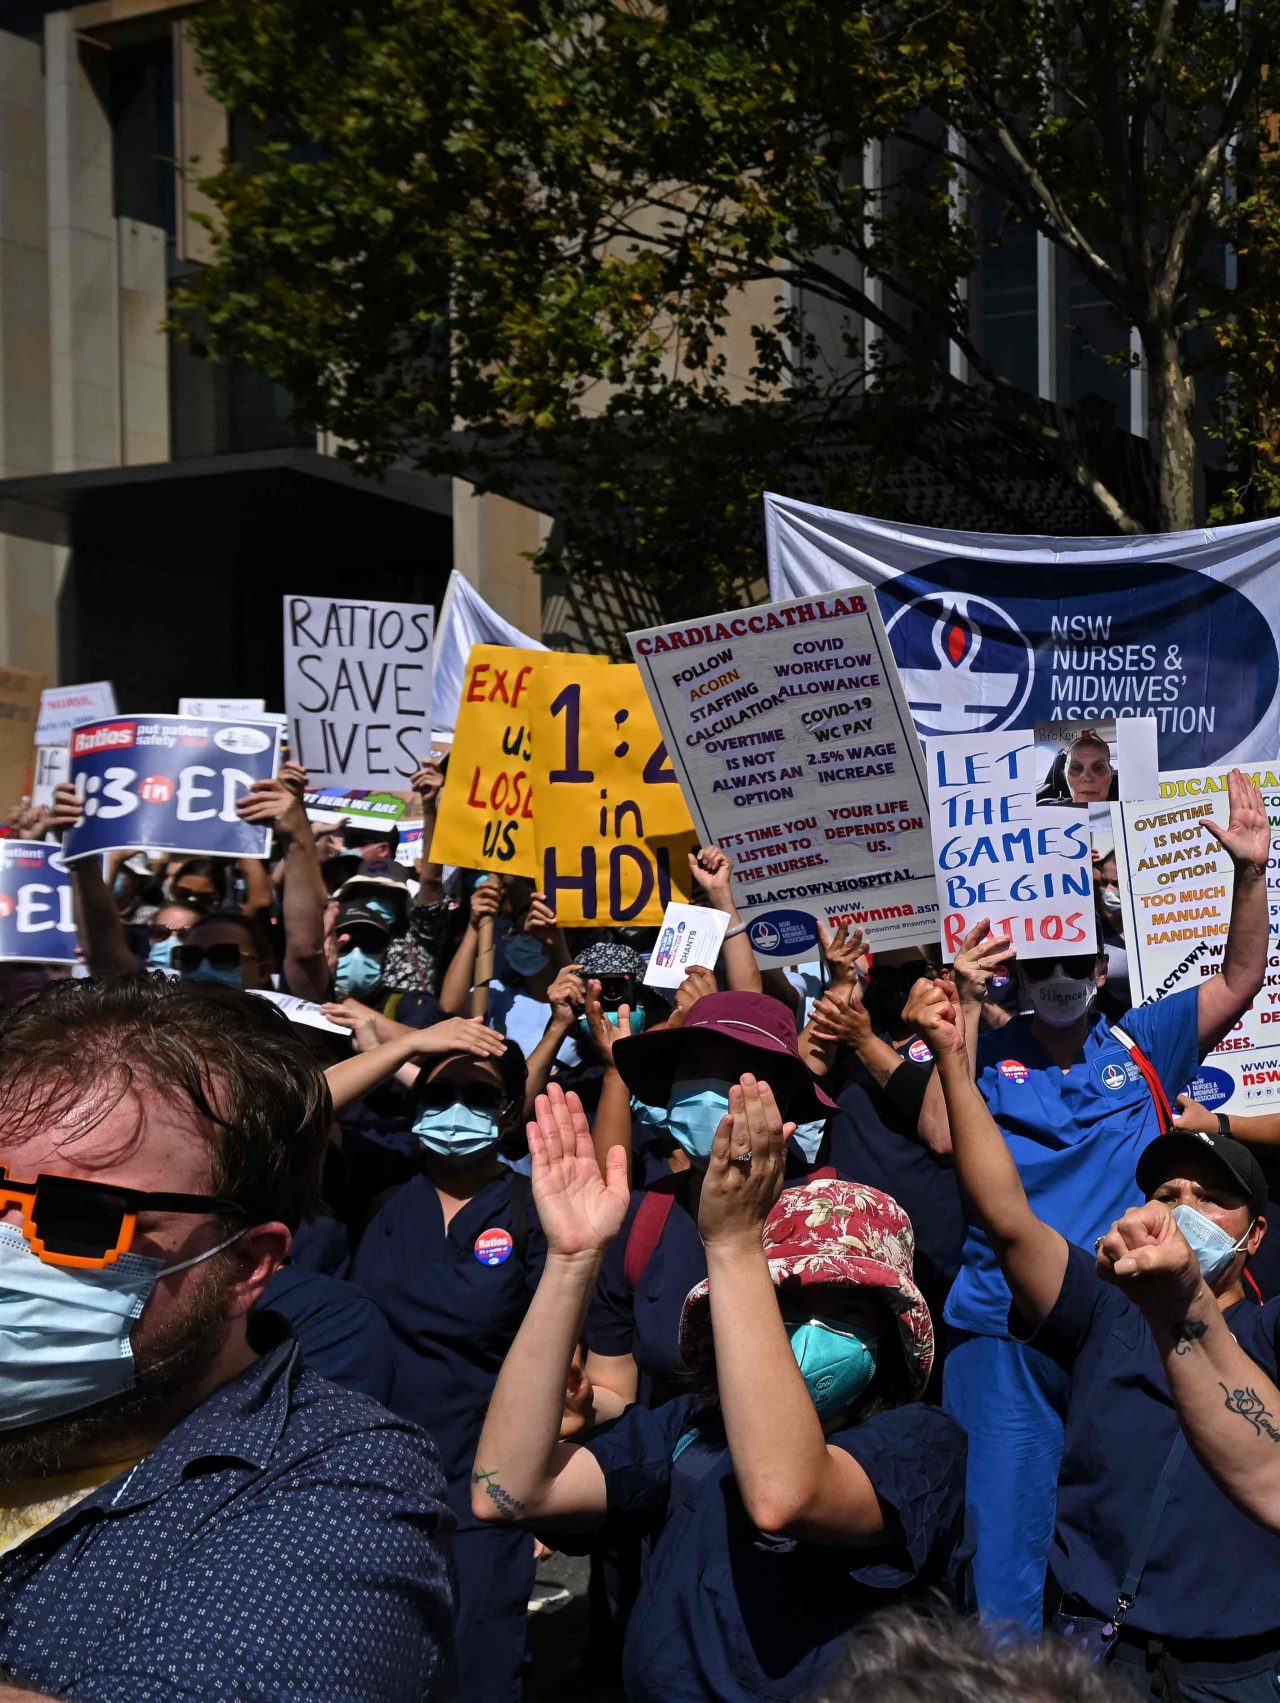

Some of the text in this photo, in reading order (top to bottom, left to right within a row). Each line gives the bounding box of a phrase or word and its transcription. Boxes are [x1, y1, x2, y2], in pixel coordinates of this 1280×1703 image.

[289, 598, 430, 653] RATIOS
[636, 595, 868, 656] CARDIAC CATH LAB
[1050, 615, 1112, 641] NSW
[792, 637, 844, 655] COVID
[1052, 644, 1183, 671] NURSES &
[672, 648, 734, 688] FOLLOW
[774, 654, 872, 677] WORKFLOW
[297, 654, 425, 716] SAVE
[690, 669, 741, 702] ACORN
[778, 674, 881, 698] ALLOWANCE
[1051, 675, 1187, 702] MIDWIVES'
[690, 682, 759, 723] STAFFING
[801, 697, 872, 725] COVID-19
[137, 725, 209, 738] put patient
[685, 695, 784, 747] CALCULATION
[814, 718, 873, 743] WC PAY
[75, 728, 133, 753] Ratios
[136, 734, 176, 748] safety
[294, 718, 422, 778] LIVES
[704, 728, 786, 754] OVERTIME
[725, 751, 776, 771] IS NOT
[806, 743, 897, 766] 2.5% WAGE
[936, 744, 1034, 787] LET
[712, 766, 804, 793] ALWAYS AN
[818, 763, 895, 783] INCREASE
[142, 777, 169, 801] in
[733, 786, 794, 807] OPTION
[600, 789, 644, 838] in
[828, 800, 909, 821] YOUR LIFE
[941, 791, 1032, 828] THE
[1134, 803, 1214, 831] OVERTIME
[718, 817, 817, 849] IT'S TIME YOU
[824, 818, 923, 840] DEPENDS ON
[1154, 826, 1203, 847] IS NOT
[737, 838, 812, 864] LISTEN TO
[866, 840, 891, 853] US.
[939, 823, 1088, 870] GAMES
[1138, 846, 1201, 871] ALWAYS
[734, 853, 829, 883] THE NURSES.
[1157, 861, 1217, 885] OPTION
[745, 869, 915, 905] BLACTOWN HOSPITAL
[946, 867, 1091, 908] BEGIN
[1141, 886, 1226, 908] TOO MUCH
[824, 901, 865, 915] www.
[1152, 906, 1221, 926] MANUAL
[944, 912, 1086, 953] RTIOS
[1147, 923, 1230, 945] HANDLING
[680, 930, 697, 963] CHANTS
[1241, 1060, 1280, 1072] www.
